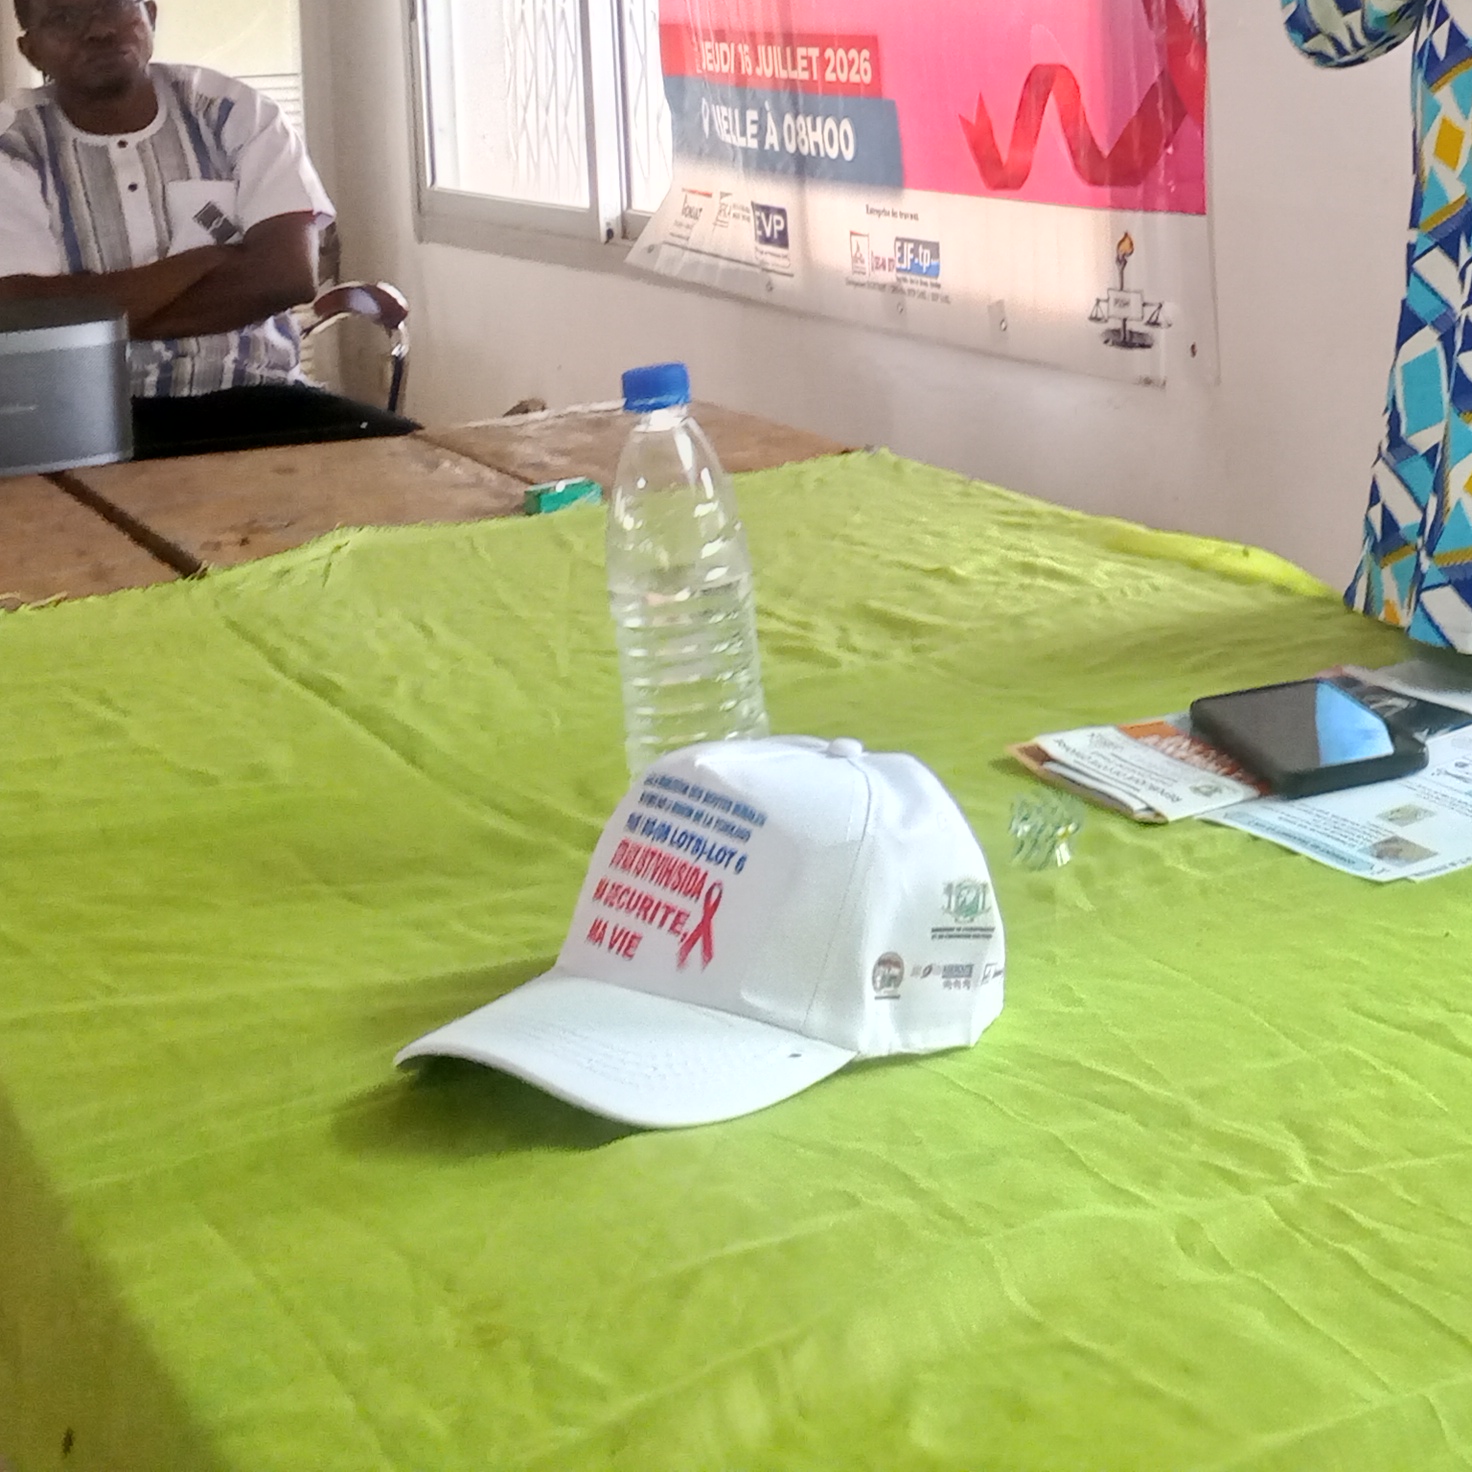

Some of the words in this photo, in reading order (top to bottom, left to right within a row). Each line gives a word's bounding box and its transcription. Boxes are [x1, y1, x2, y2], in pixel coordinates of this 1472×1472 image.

[698, 40, 735, 75] JEUDI
[737, 42, 753, 76] 16
[754, 44, 820, 81] JUILLET
[824, 47, 872, 85] 2026
[763, 99, 780, 153] À
[783, 110, 857, 162] 08H00
[754, 210, 785, 241] EVP
[735, 853, 748, 876] 6
[607, 922, 644, 962] VIE
